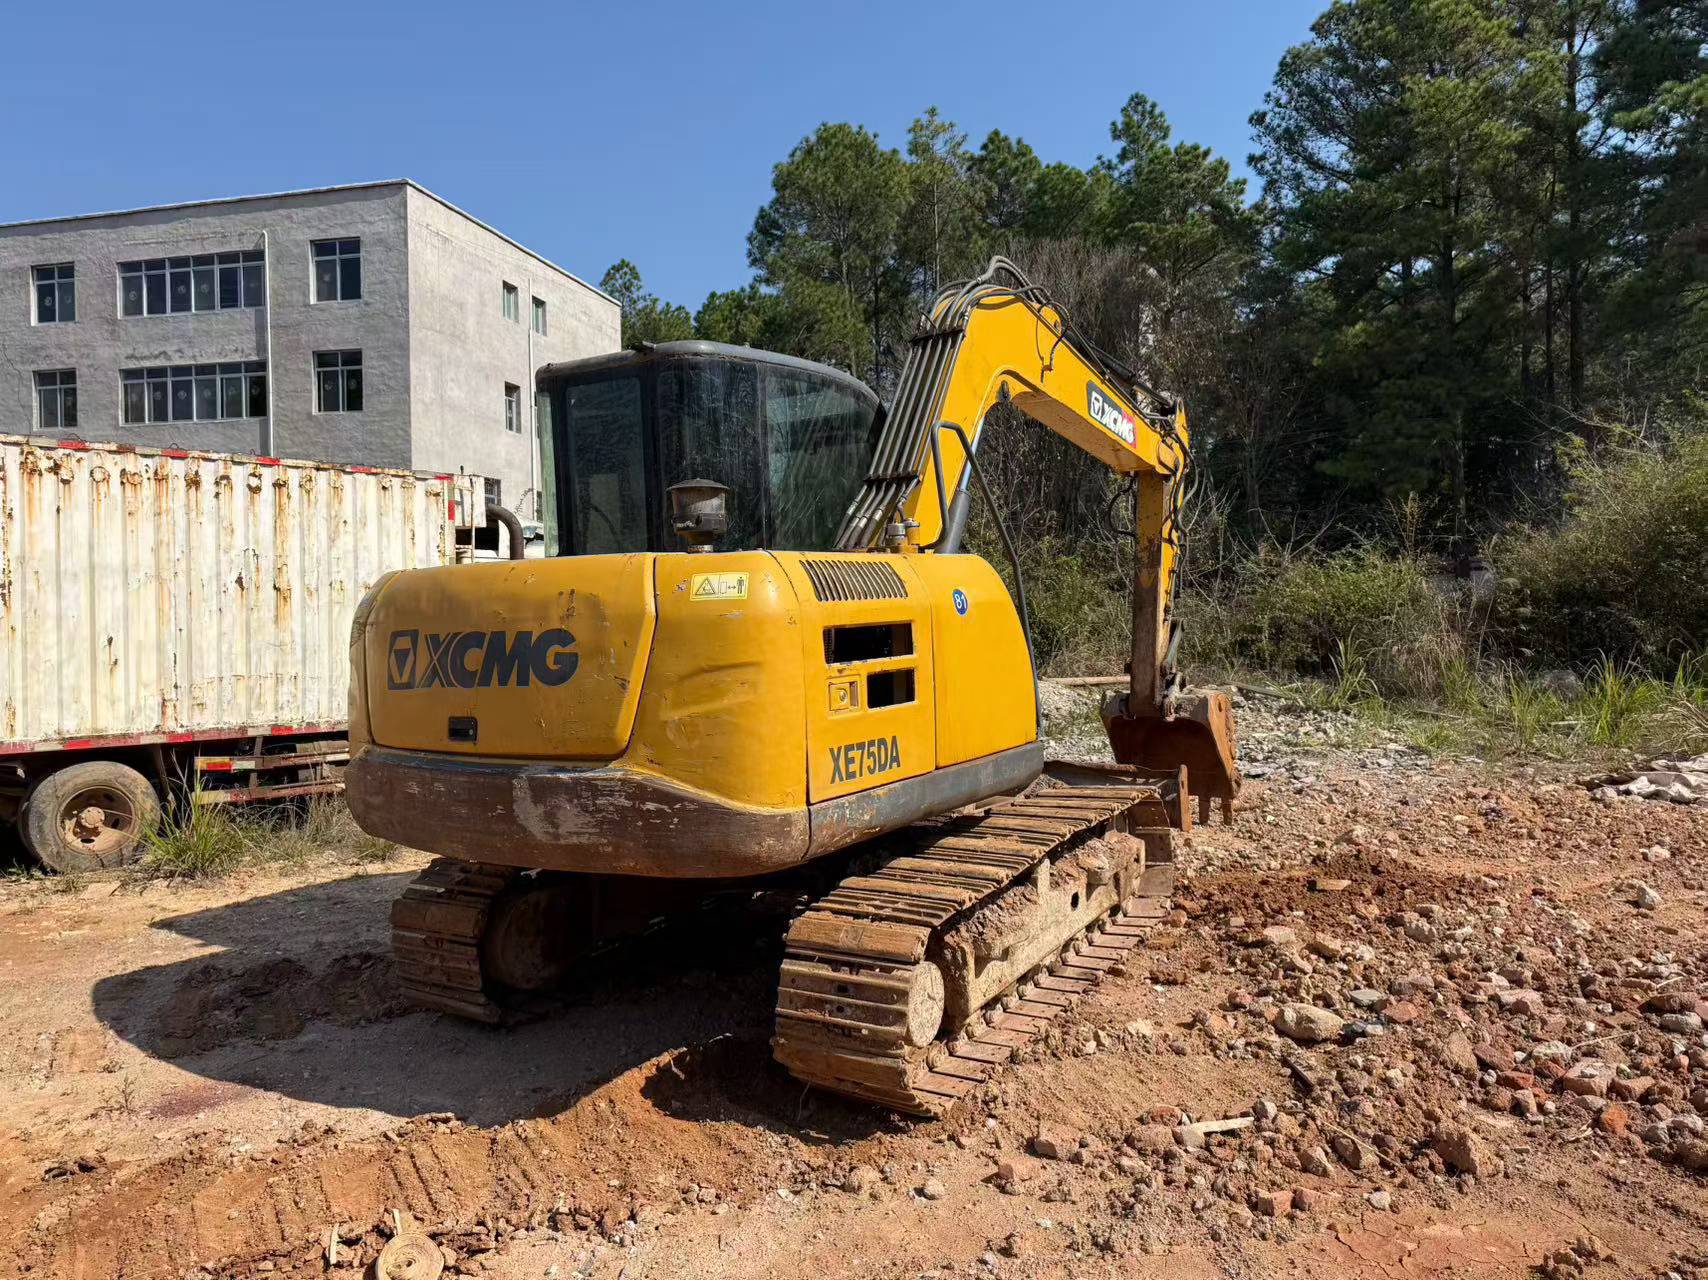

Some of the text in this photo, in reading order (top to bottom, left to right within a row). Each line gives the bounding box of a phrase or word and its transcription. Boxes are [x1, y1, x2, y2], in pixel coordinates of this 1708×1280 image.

[1101, 402, 1135, 444] XCMG
[954, 593, 967, 609] 81
[416, 628, 580, 688] XCMG
[828, 735, 901, 785] XE75DA
